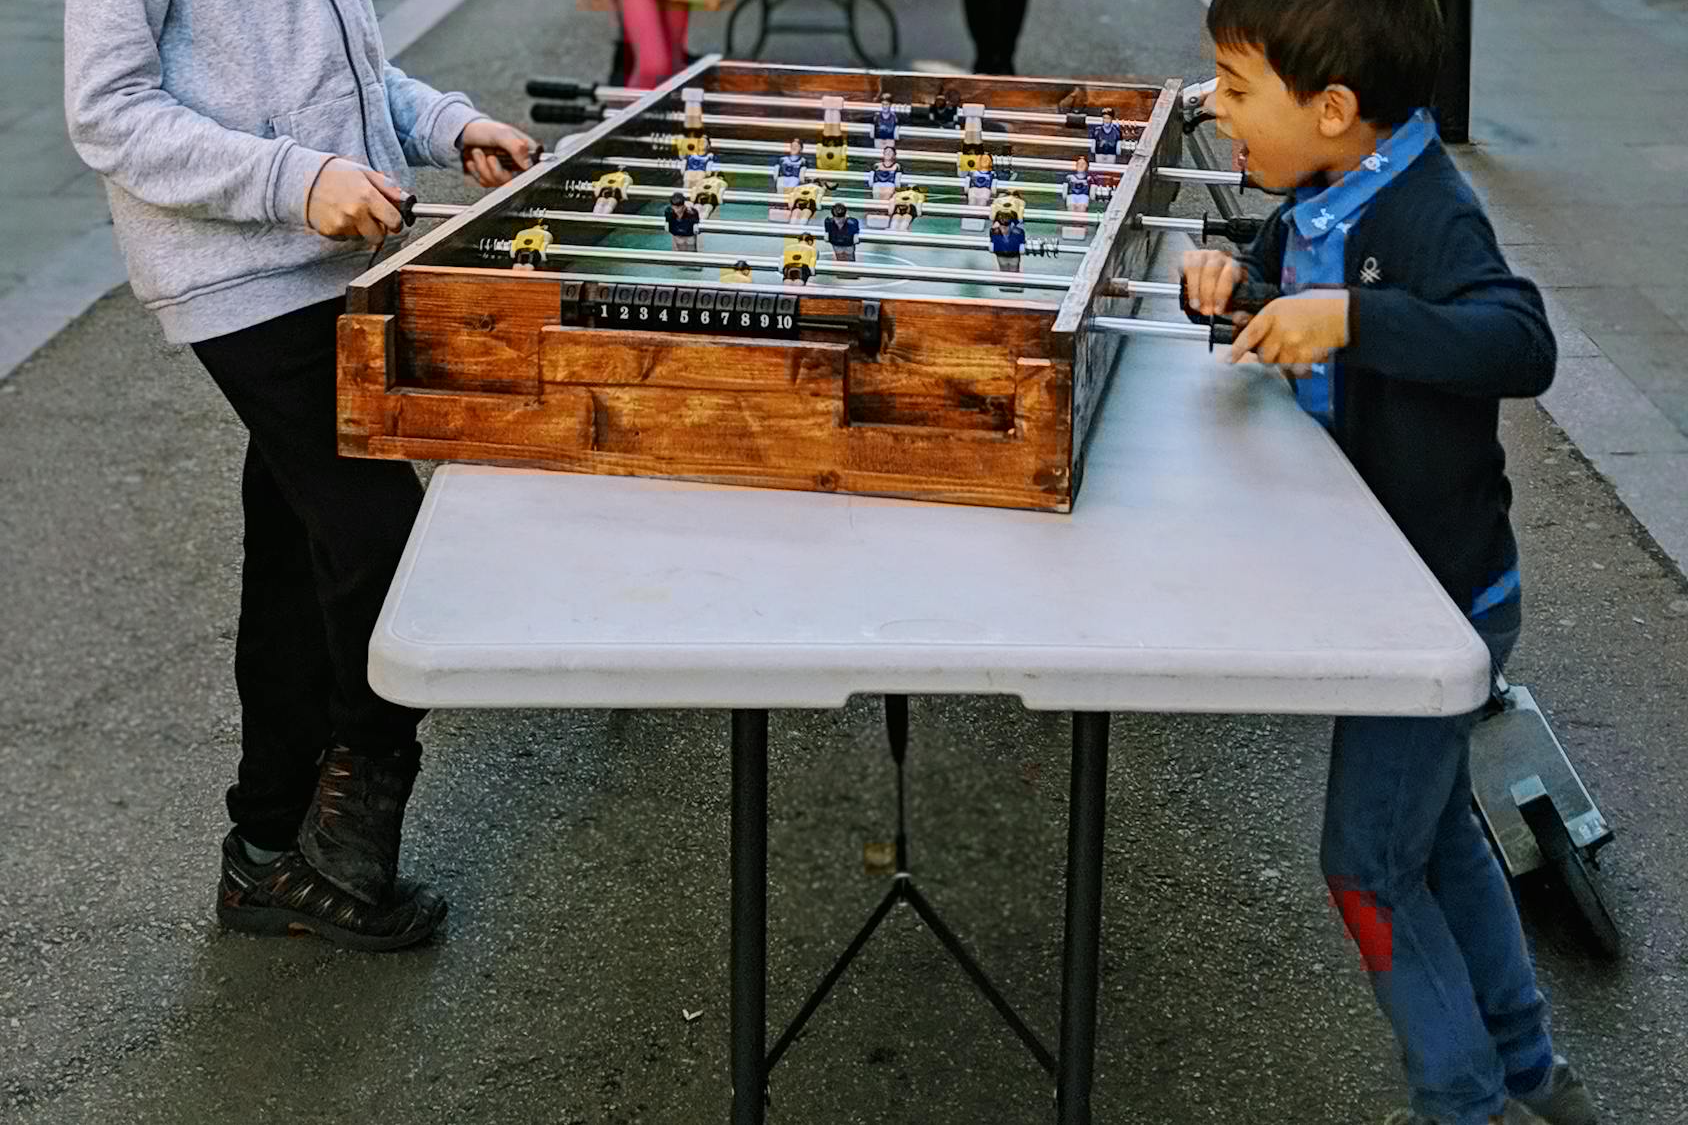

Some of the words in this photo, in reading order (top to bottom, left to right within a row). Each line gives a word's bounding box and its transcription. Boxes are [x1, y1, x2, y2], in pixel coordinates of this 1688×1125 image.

[601, 304, 608, 318] 1
[619, 305, 629, 320] 2
[639, 306, 649, 320] 3
[658, 308, 668, 322] 4
[679, 310, 689, 323] 5
[700, 310, 710, 324] 6
[720, 311, 730, 325] 7
[740, 312, 750, 327] 8
[760, 313, 769, 328] 9
[776, 315, 793, 329] 10
